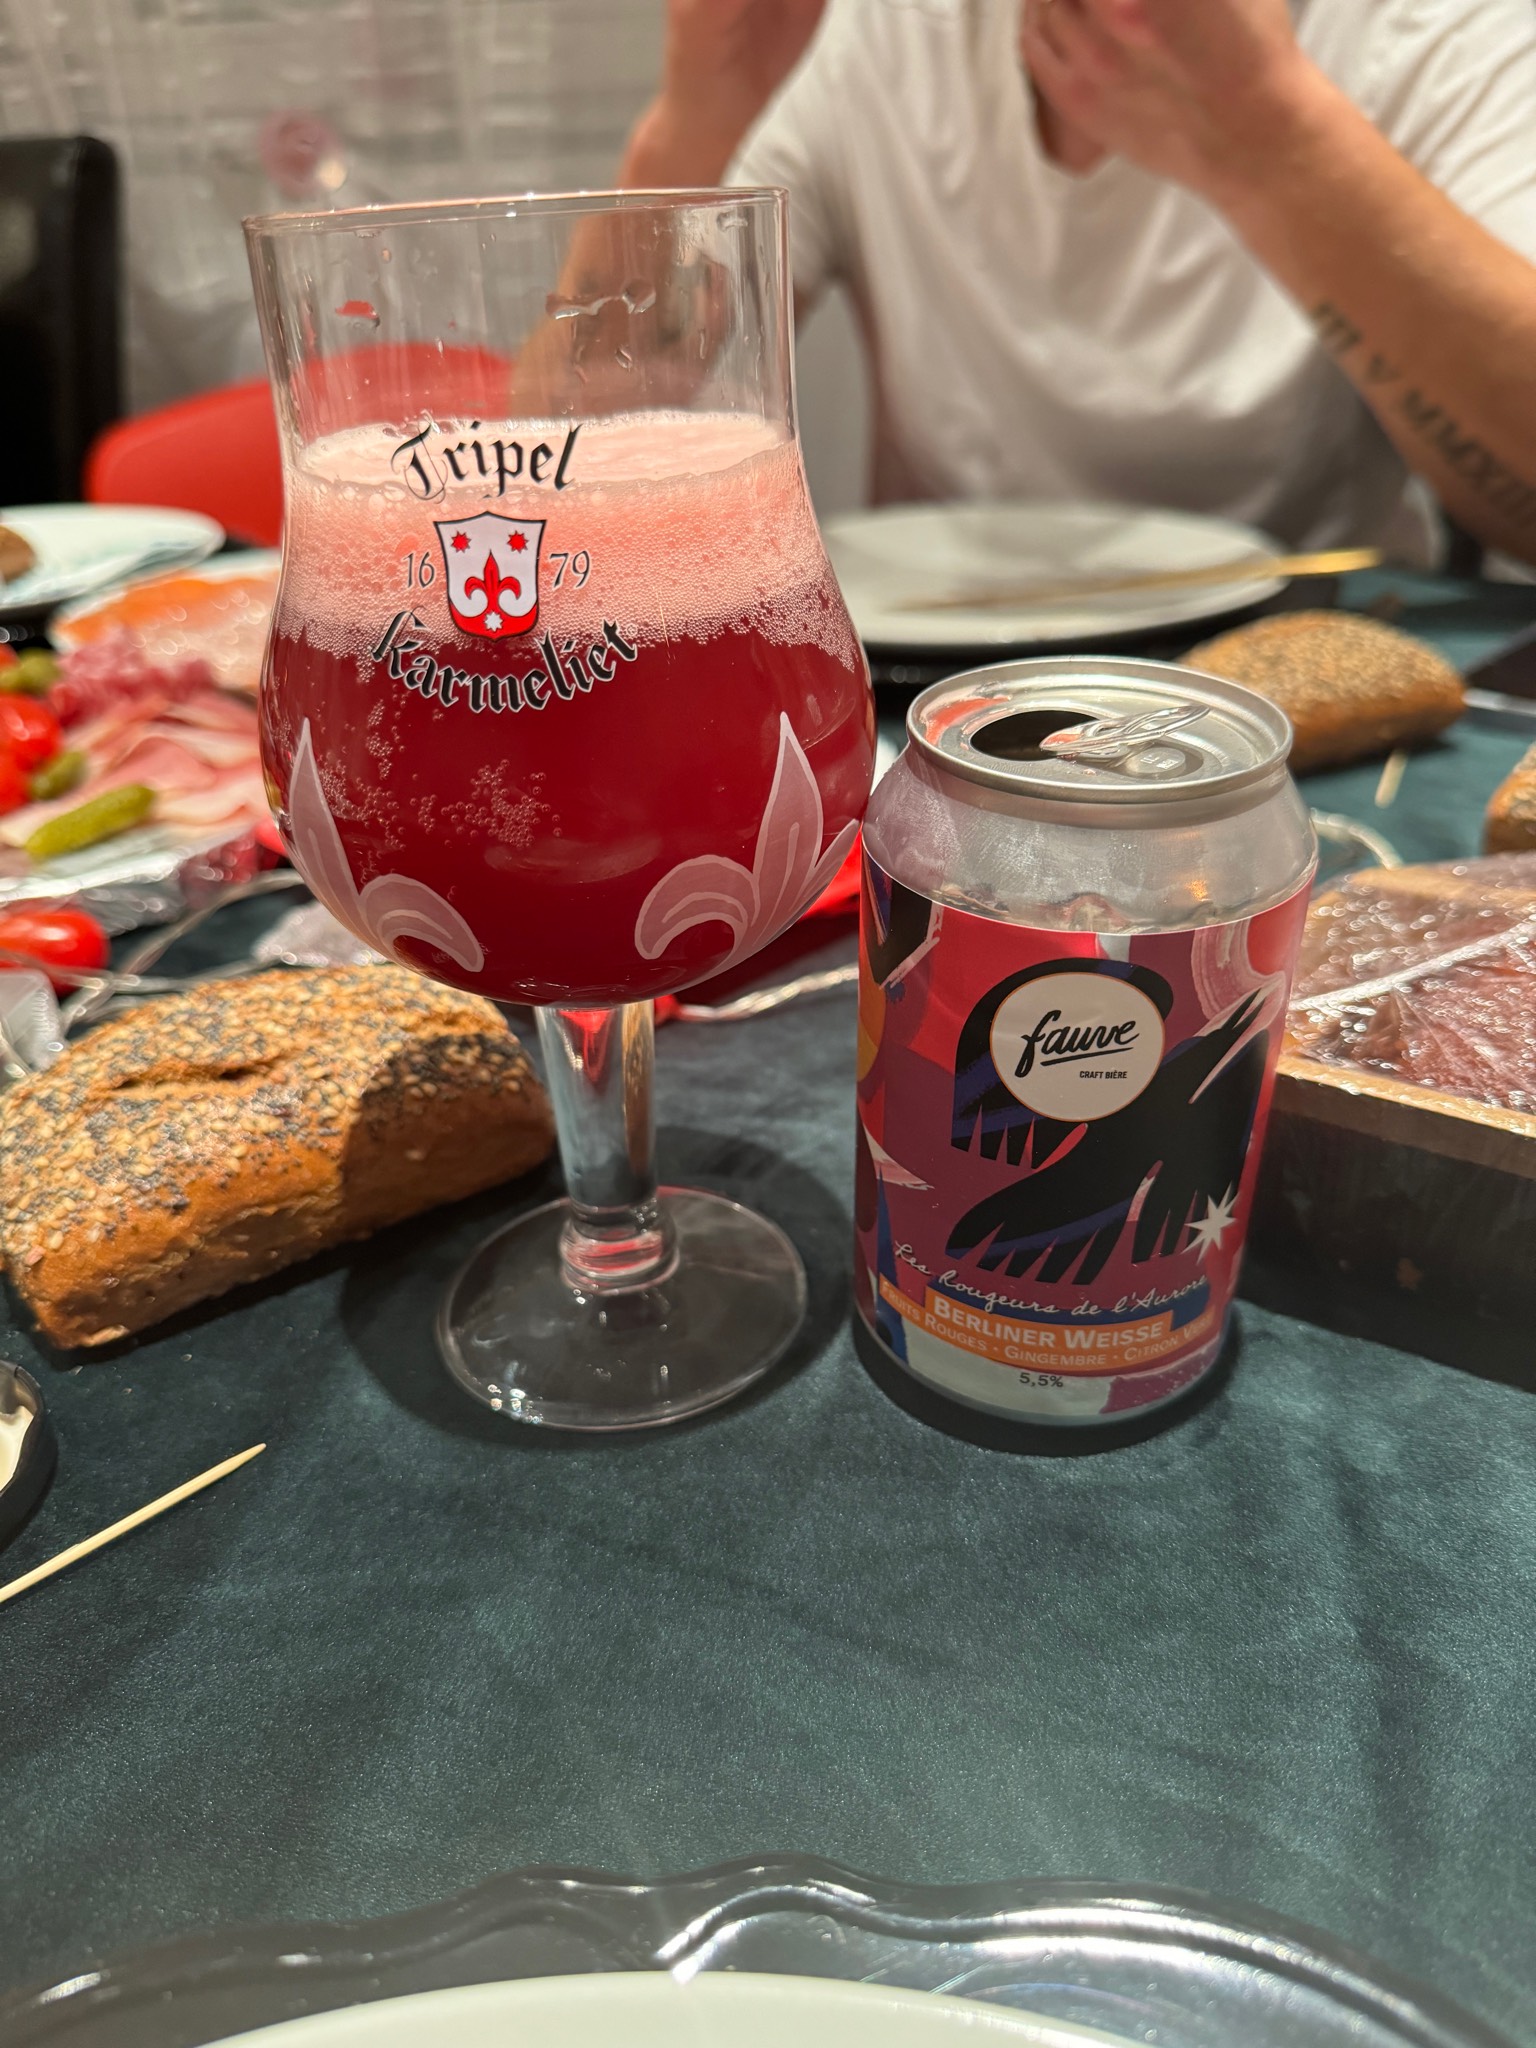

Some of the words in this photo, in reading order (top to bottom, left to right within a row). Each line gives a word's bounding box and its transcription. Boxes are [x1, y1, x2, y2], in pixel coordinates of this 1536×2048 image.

[391, 420, 584, 503] Tripel
[403, 551, 436, 589] 16
[549, 550, 592, 589] 79
[370, 606, 638, 714] Karmeliet
[1014, 1009, 1140, 1078] fauve
[1079, 1070, 1104, 1080] CRAFT
[1104, 1069, 1128, 1080] BIÈRE
[894, 1240, 932, 1275] Les
[938, 1269, 1061, 1314] Rougeurs
[1070, 1299, 1103, 1317] de
[924, 1312, 989, 1352] ROUGES
[1003, 1345, 1107, 1367] GINGEMBRE
[1123, 1335, 1180, 1361] CITRON
[933, 1295, 1057, 1349] BERLINER
[1063, 1321, 1164, 1350] WEISSE
[1018, 1371, 1064, 1388] 5,5%
